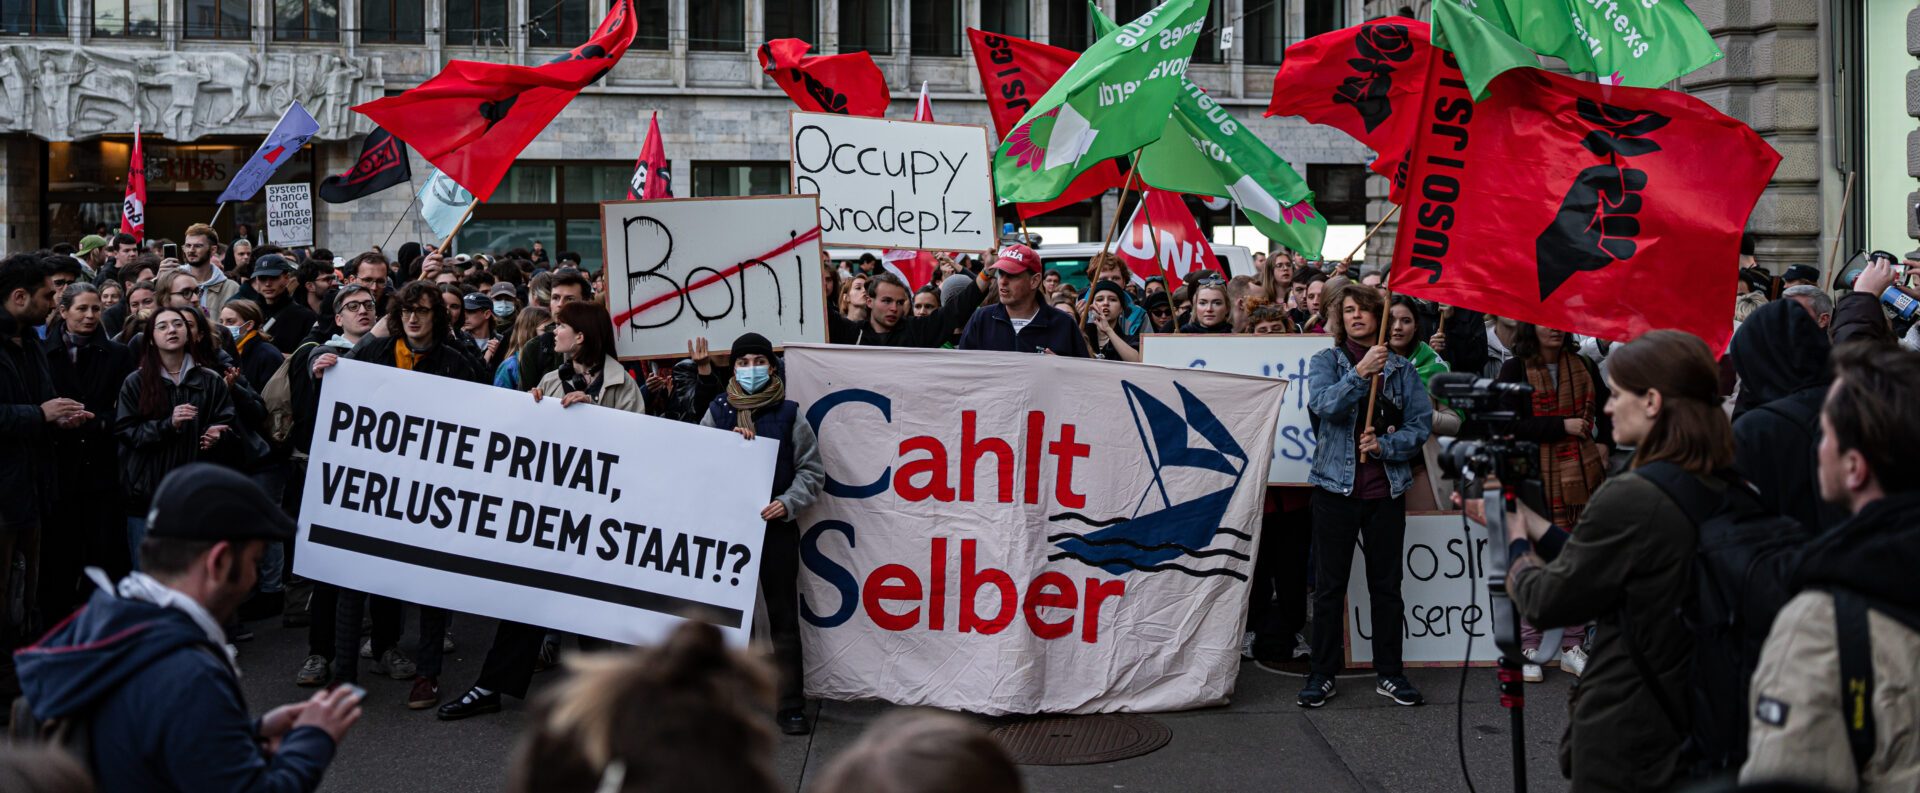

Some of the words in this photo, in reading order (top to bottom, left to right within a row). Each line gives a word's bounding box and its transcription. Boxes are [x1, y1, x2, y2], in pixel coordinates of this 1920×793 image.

[796, 125, 968, 195] Occupy
[1431, 96, 1474, 152] JS
[269, 184, 307, 194] system
[269, 192, 308, 202] change
[269, 209, 311, 218] climate
[269, 216, 311, 227] change!
[1410, 174, 1461, 284] JUSO
[622, 216, 805, 338] Boni
[328, 401, 480, 470] PROFITE
[483, 431, 622, 503] PRIVAT,
[805, 388, 1090, 509] Cahlt
[321, 462, 504, 539] VERLUSTE
[506, 501, 592, 556] DEM
[596, 517, 752, 587] STAAT!?
[800, 519, 1125, 643] Selber
